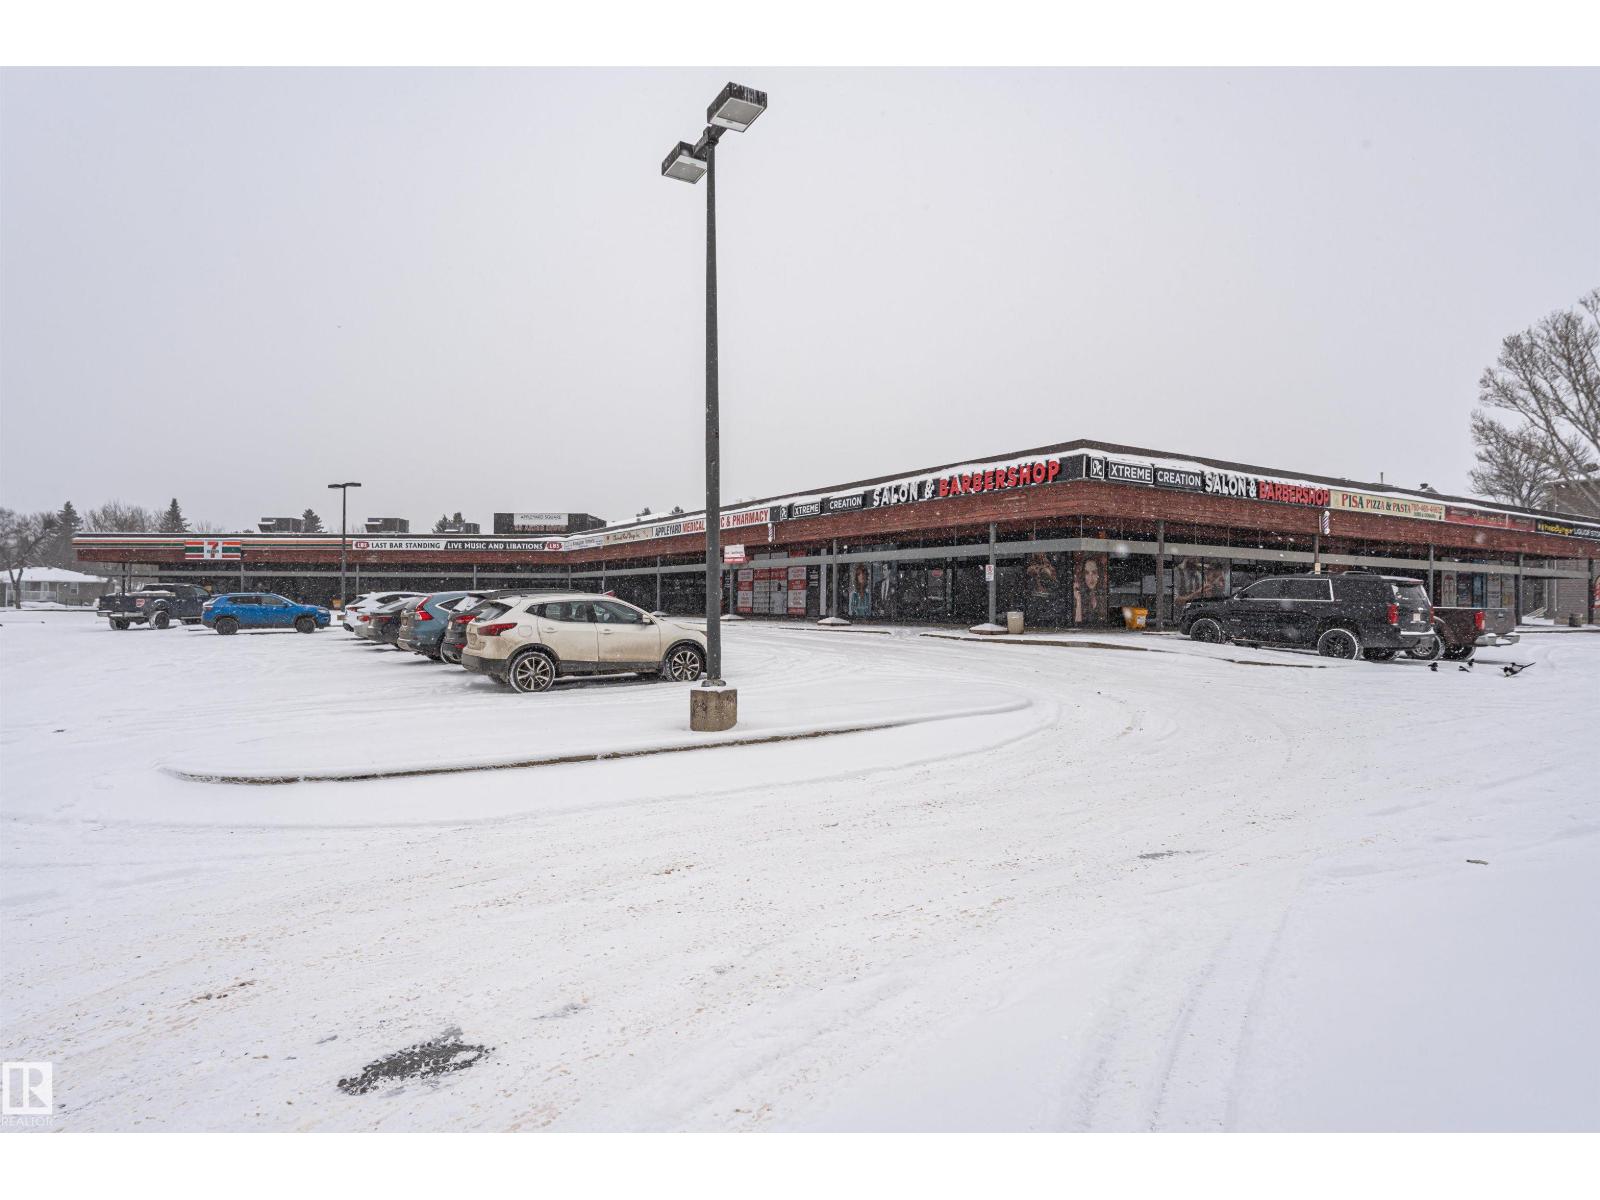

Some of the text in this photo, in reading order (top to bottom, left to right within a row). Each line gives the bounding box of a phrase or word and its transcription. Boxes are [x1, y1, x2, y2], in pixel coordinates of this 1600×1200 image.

[873, 459, 1060, 507] SALON & BARBERSHOP
[1111, 464, 1329, 506] XTREME CREATION SALON & BARBERSHOP
[794, 496, 862, 515] XTREME CREATION
[1341, 493, 1364, 509] PISA
[1366, 499, 1385, 511] PIZZA
[1386, 502, 1392, 511] &
[1392, 503, 1411, 514] PASTA
[655, 524, 681, 537] APPLEYARD
[682, 521, 705, 533] MEDICAL
[726, 516, 731, 527] &
[732, 509, 769, 526] PHARMACY
[447, 541, 543, 550] LIVE MUSIC AND LIBATIONS
